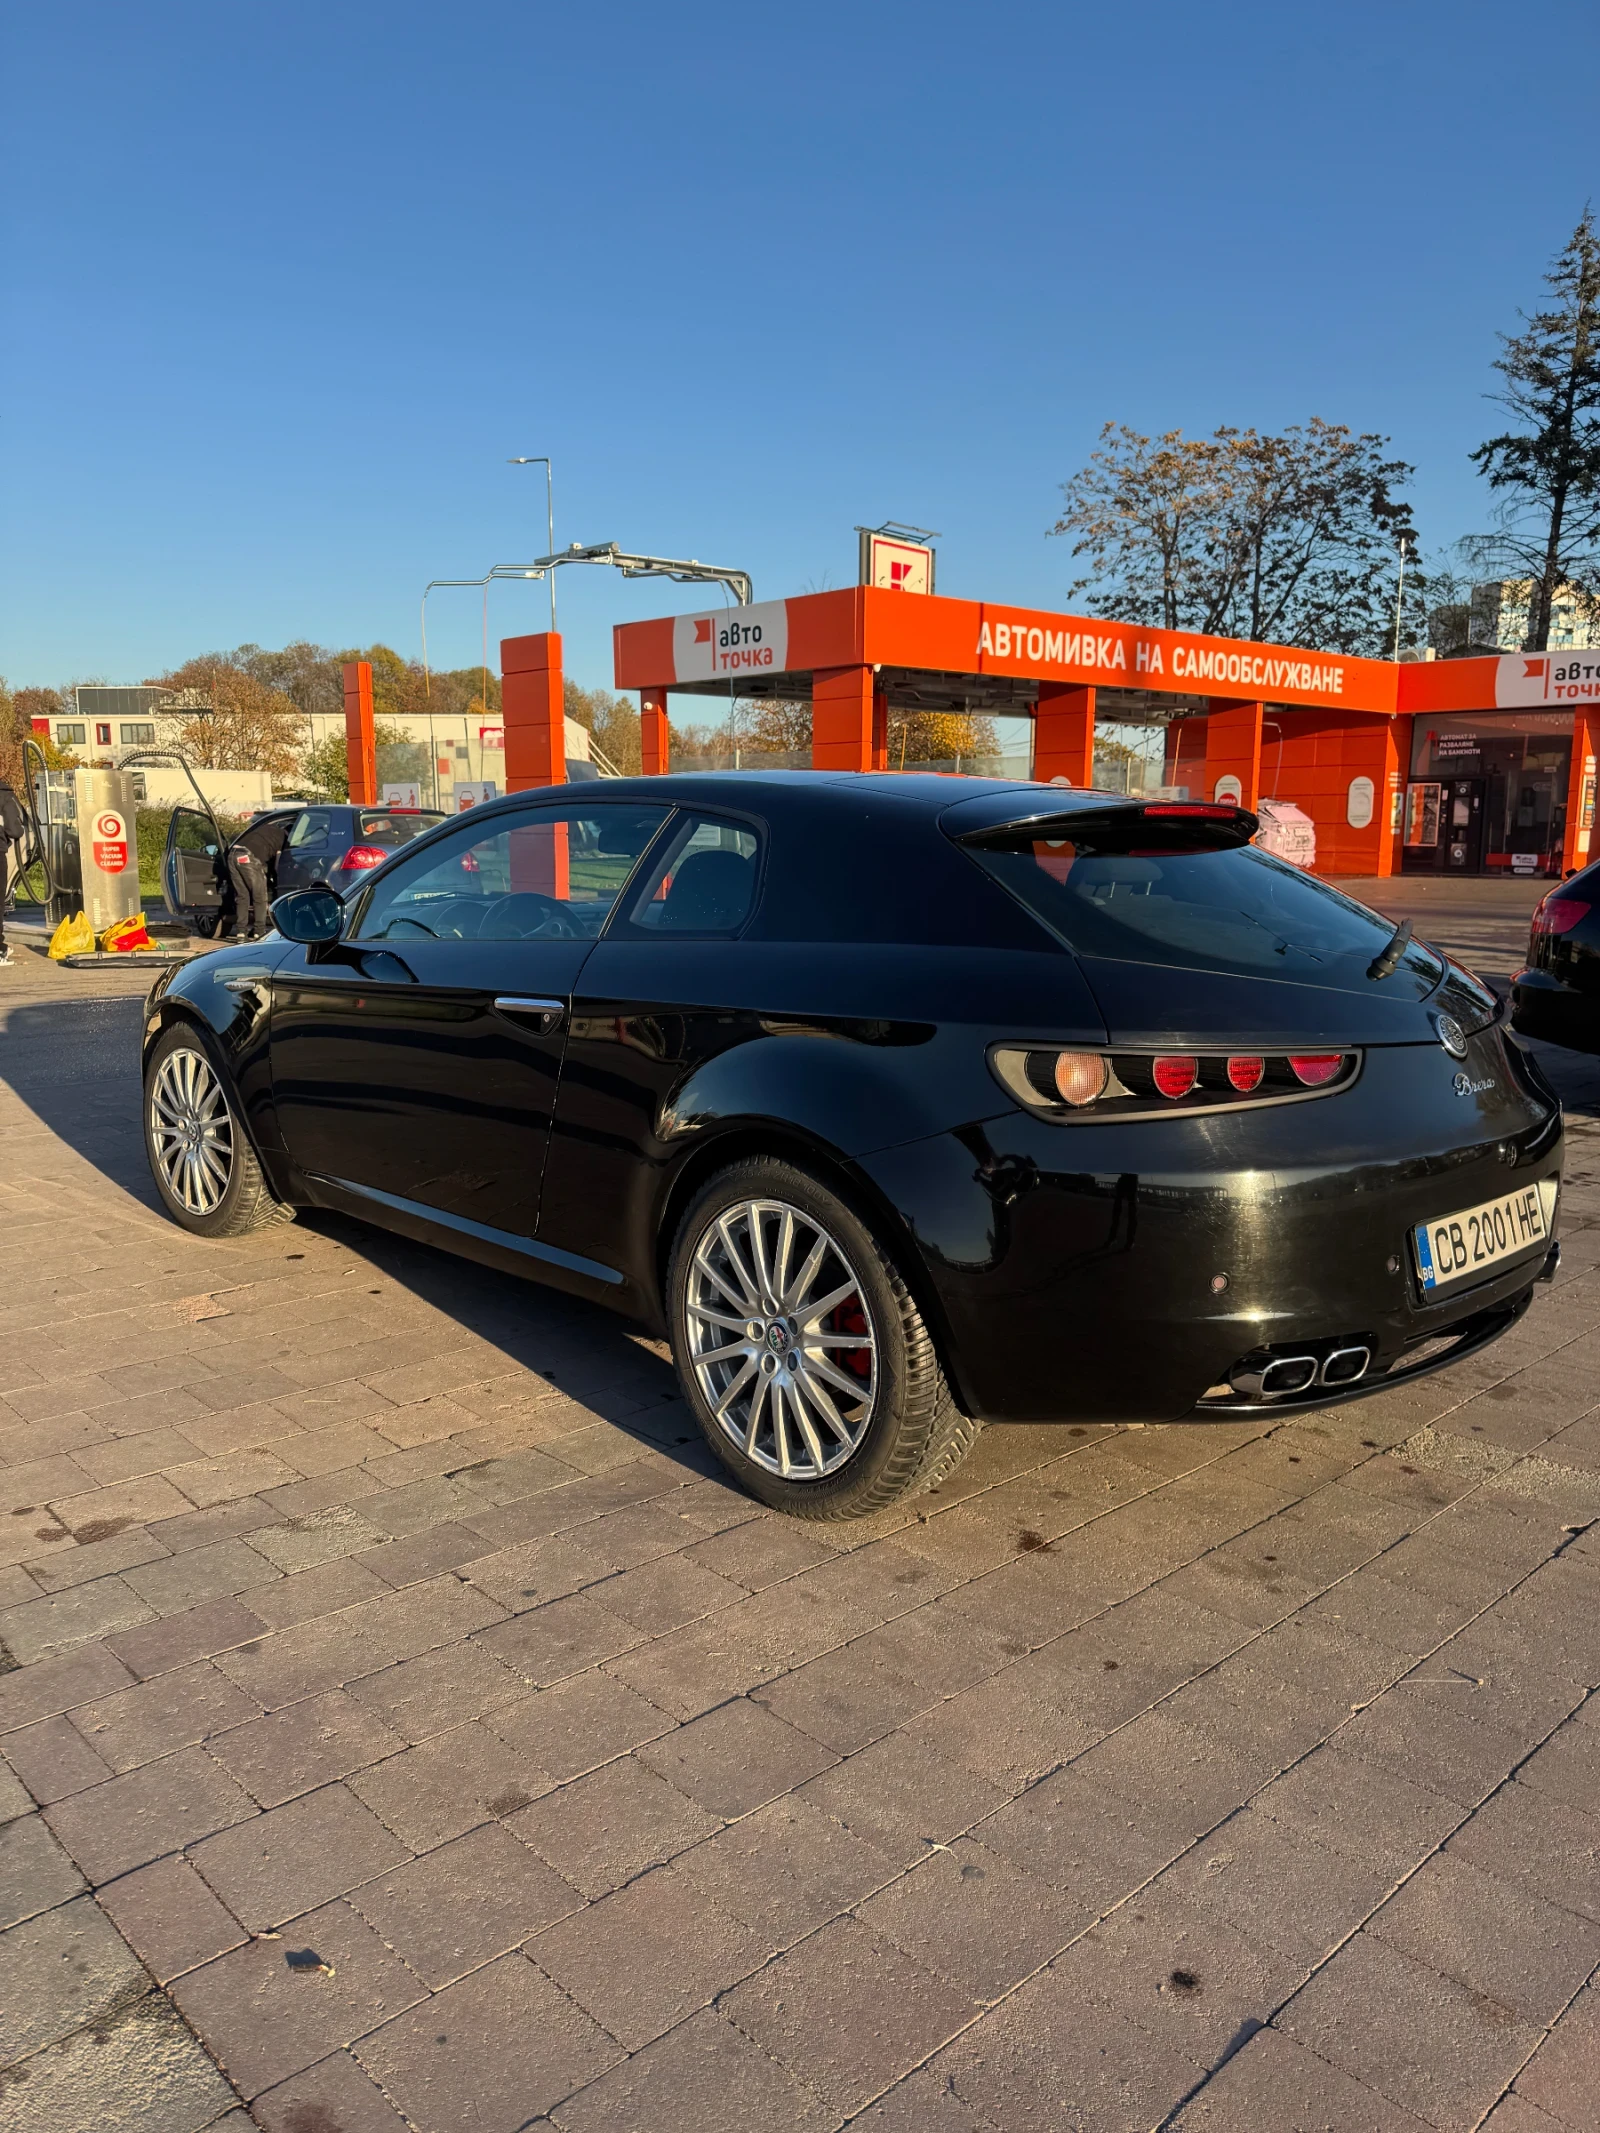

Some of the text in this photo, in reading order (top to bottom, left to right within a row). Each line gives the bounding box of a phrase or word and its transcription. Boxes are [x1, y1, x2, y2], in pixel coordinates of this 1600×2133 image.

[720, 622, 762, 647] авто
[720, 647, 773, 670] точка
[976, 621, 1344, 694] АВТОМИВКА НА САМООБСЛУЖВАНЕ
[1453, 1072, 1495, 1096] Brera
[1434, 1191, 1542, 1275] CB 2001 HE
[1422, 1265, 1434, 1281] BG
